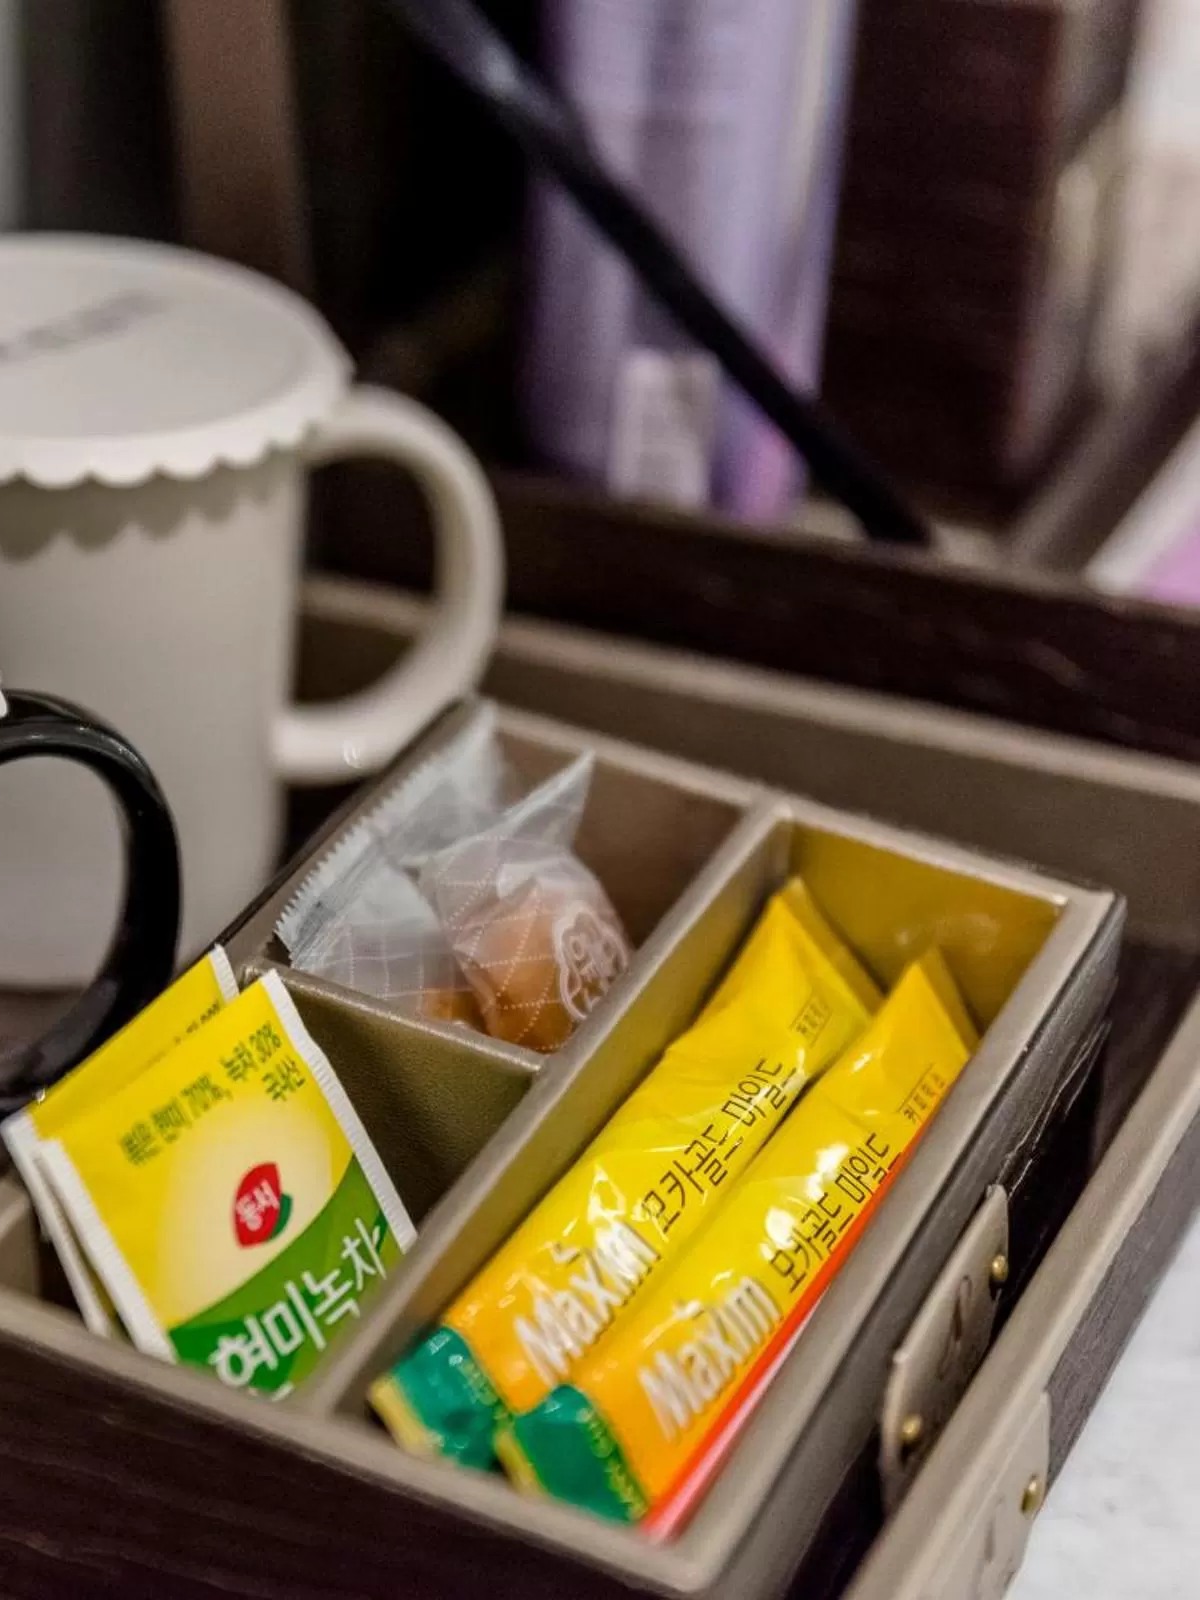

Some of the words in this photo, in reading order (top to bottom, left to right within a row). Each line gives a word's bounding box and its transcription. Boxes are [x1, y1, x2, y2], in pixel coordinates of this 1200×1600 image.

[219, 1041, 259, 1082] 녹차
[261, 1056, 306, 1102] 국산
[209, 1217, 388, 1402] 현미녹차
[513, 1218, 661, 1389] Maxim
[641, 1124, 745, 1235] 모카골드
[721, 1058, 808, 1128] 마일드
[638, 1275, 784, 1439] Maxim
[769, 1192, 855, 1294] 모카골드
